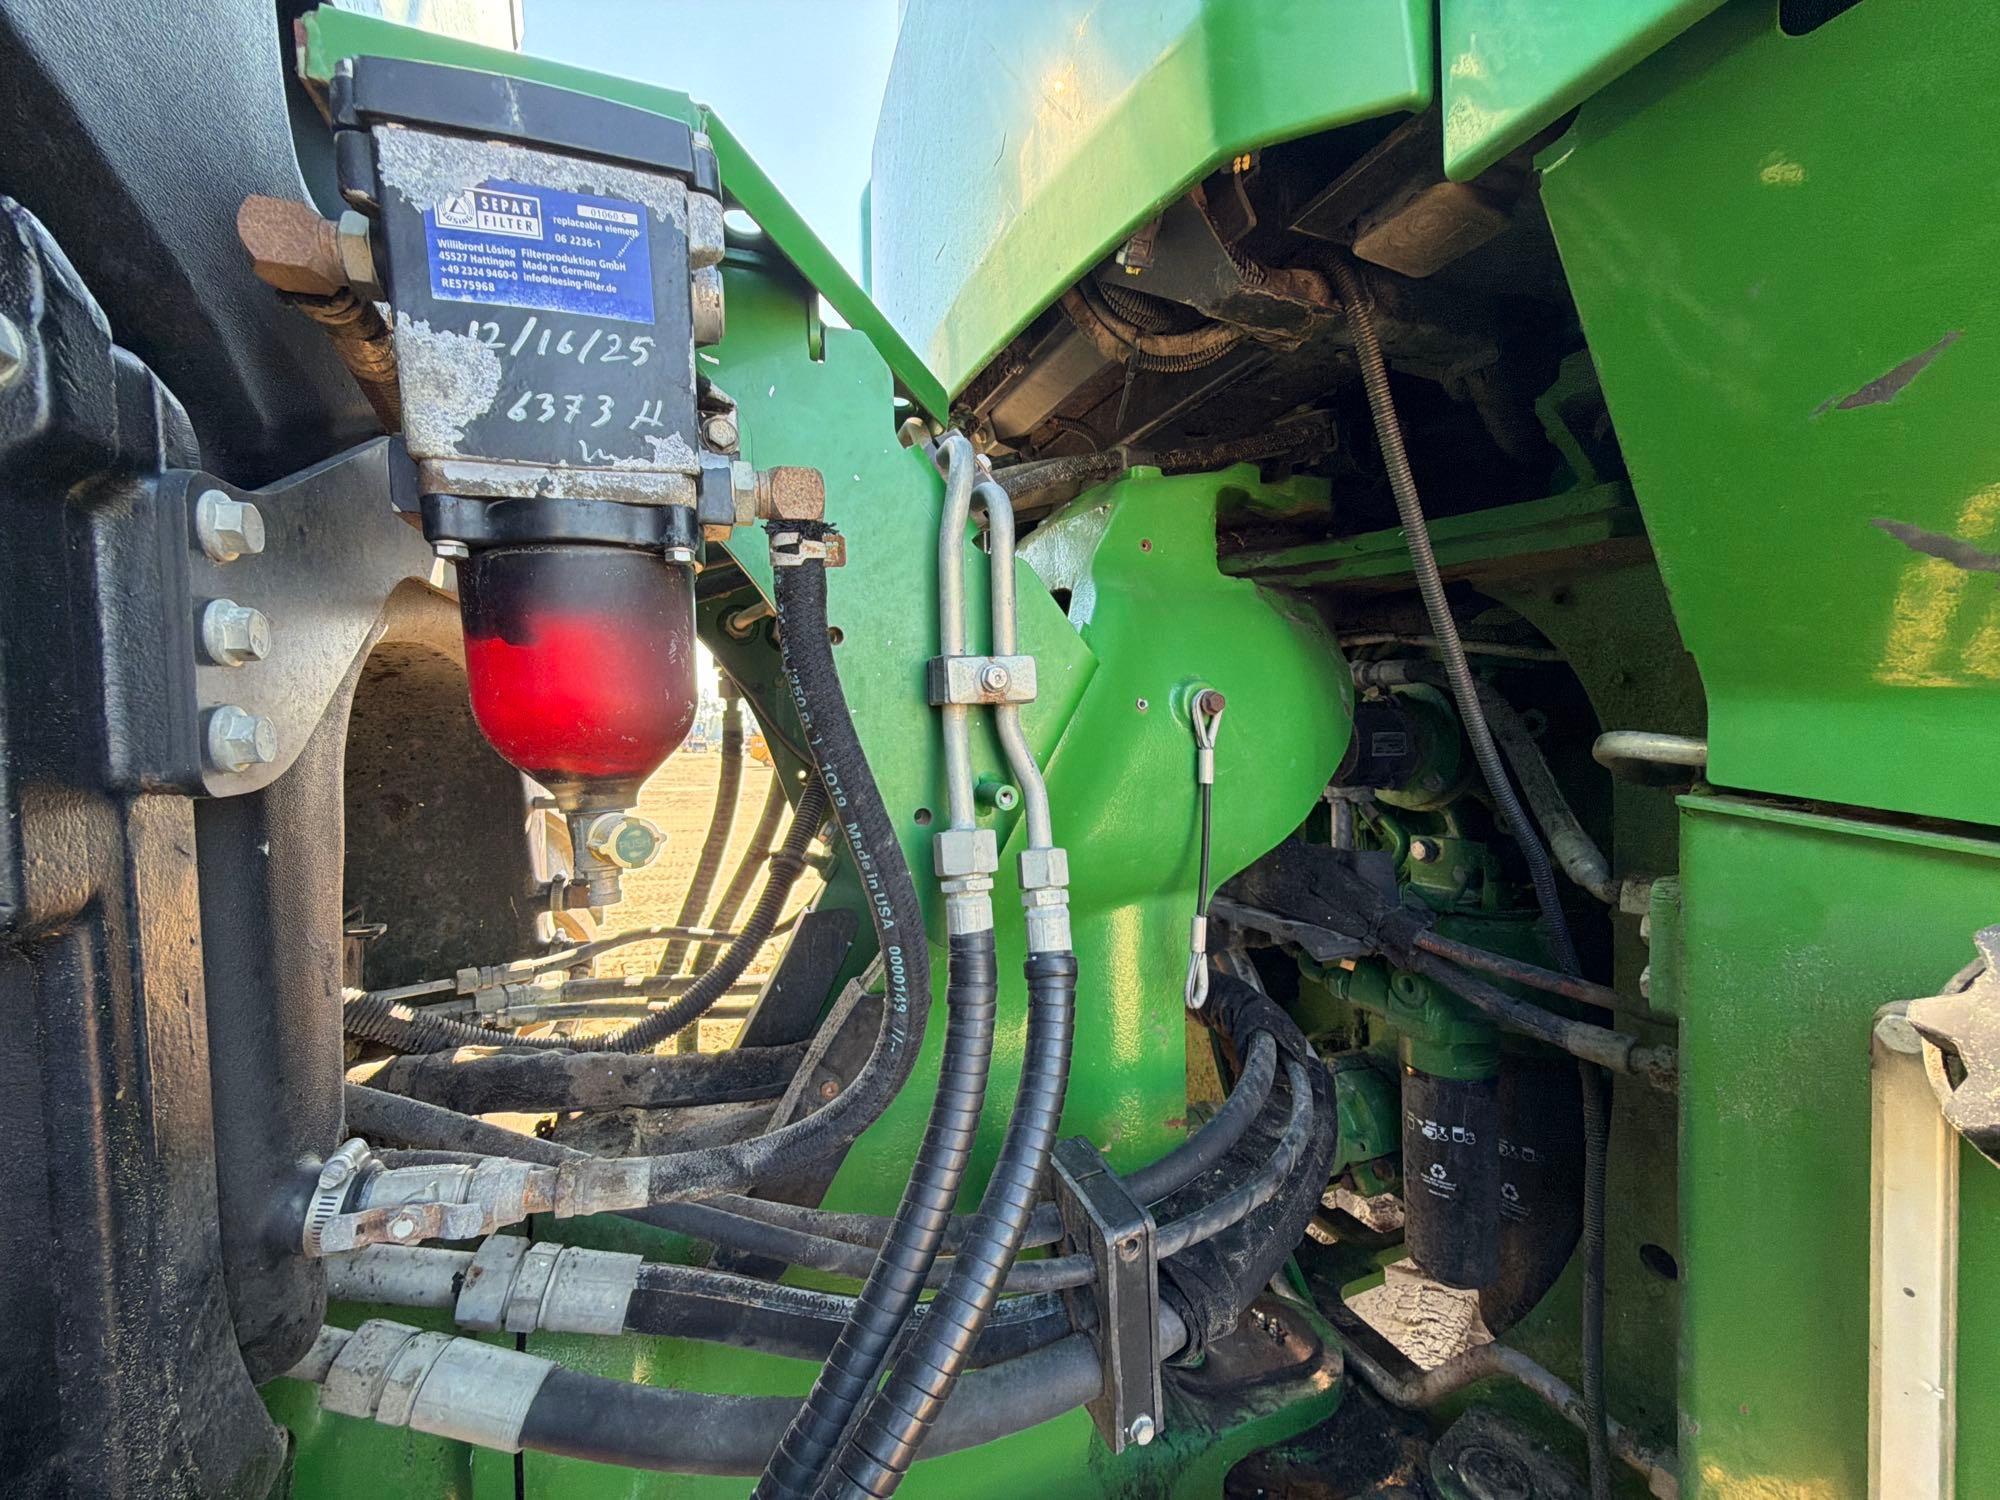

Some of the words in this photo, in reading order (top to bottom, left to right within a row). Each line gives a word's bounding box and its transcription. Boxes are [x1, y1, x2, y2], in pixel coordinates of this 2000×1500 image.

[481, 196, 532, 216] SEPAR
[484, 215, 533, 232] FILTER
[553, 216, 603, 232] replaceable
[437, 238, 484, 253] Willibrord
[486, 243, 516, 259] Lösing
[554, 232, 567, 244] 06
[570, 235, 601, 249] 2236-1
[439, 251, 468, 263] 45527
[470, 253, 516, 269] Hattingen
[521, 248, 598, 268] Filterproduktion
[599, 258, 627, 272] GmbH
[440, 264, 460, 275] +49
[461, 265, 485, 278] 2324
[486, 268, 518, 281] 9460-0
[522, 260, 549, 272] Made
[551, 262, 559, 273] in
[561, 266, 601, 281] Germany
[441, 277, 496, 293] RE575968
[468, 316, 657, 367] 12/16/25
[506, 390, 616, 428] 6373
[845, 822, 872, 871] Made
[866, 872, 879, 890] in
[873, 892, 895, 930] USA
